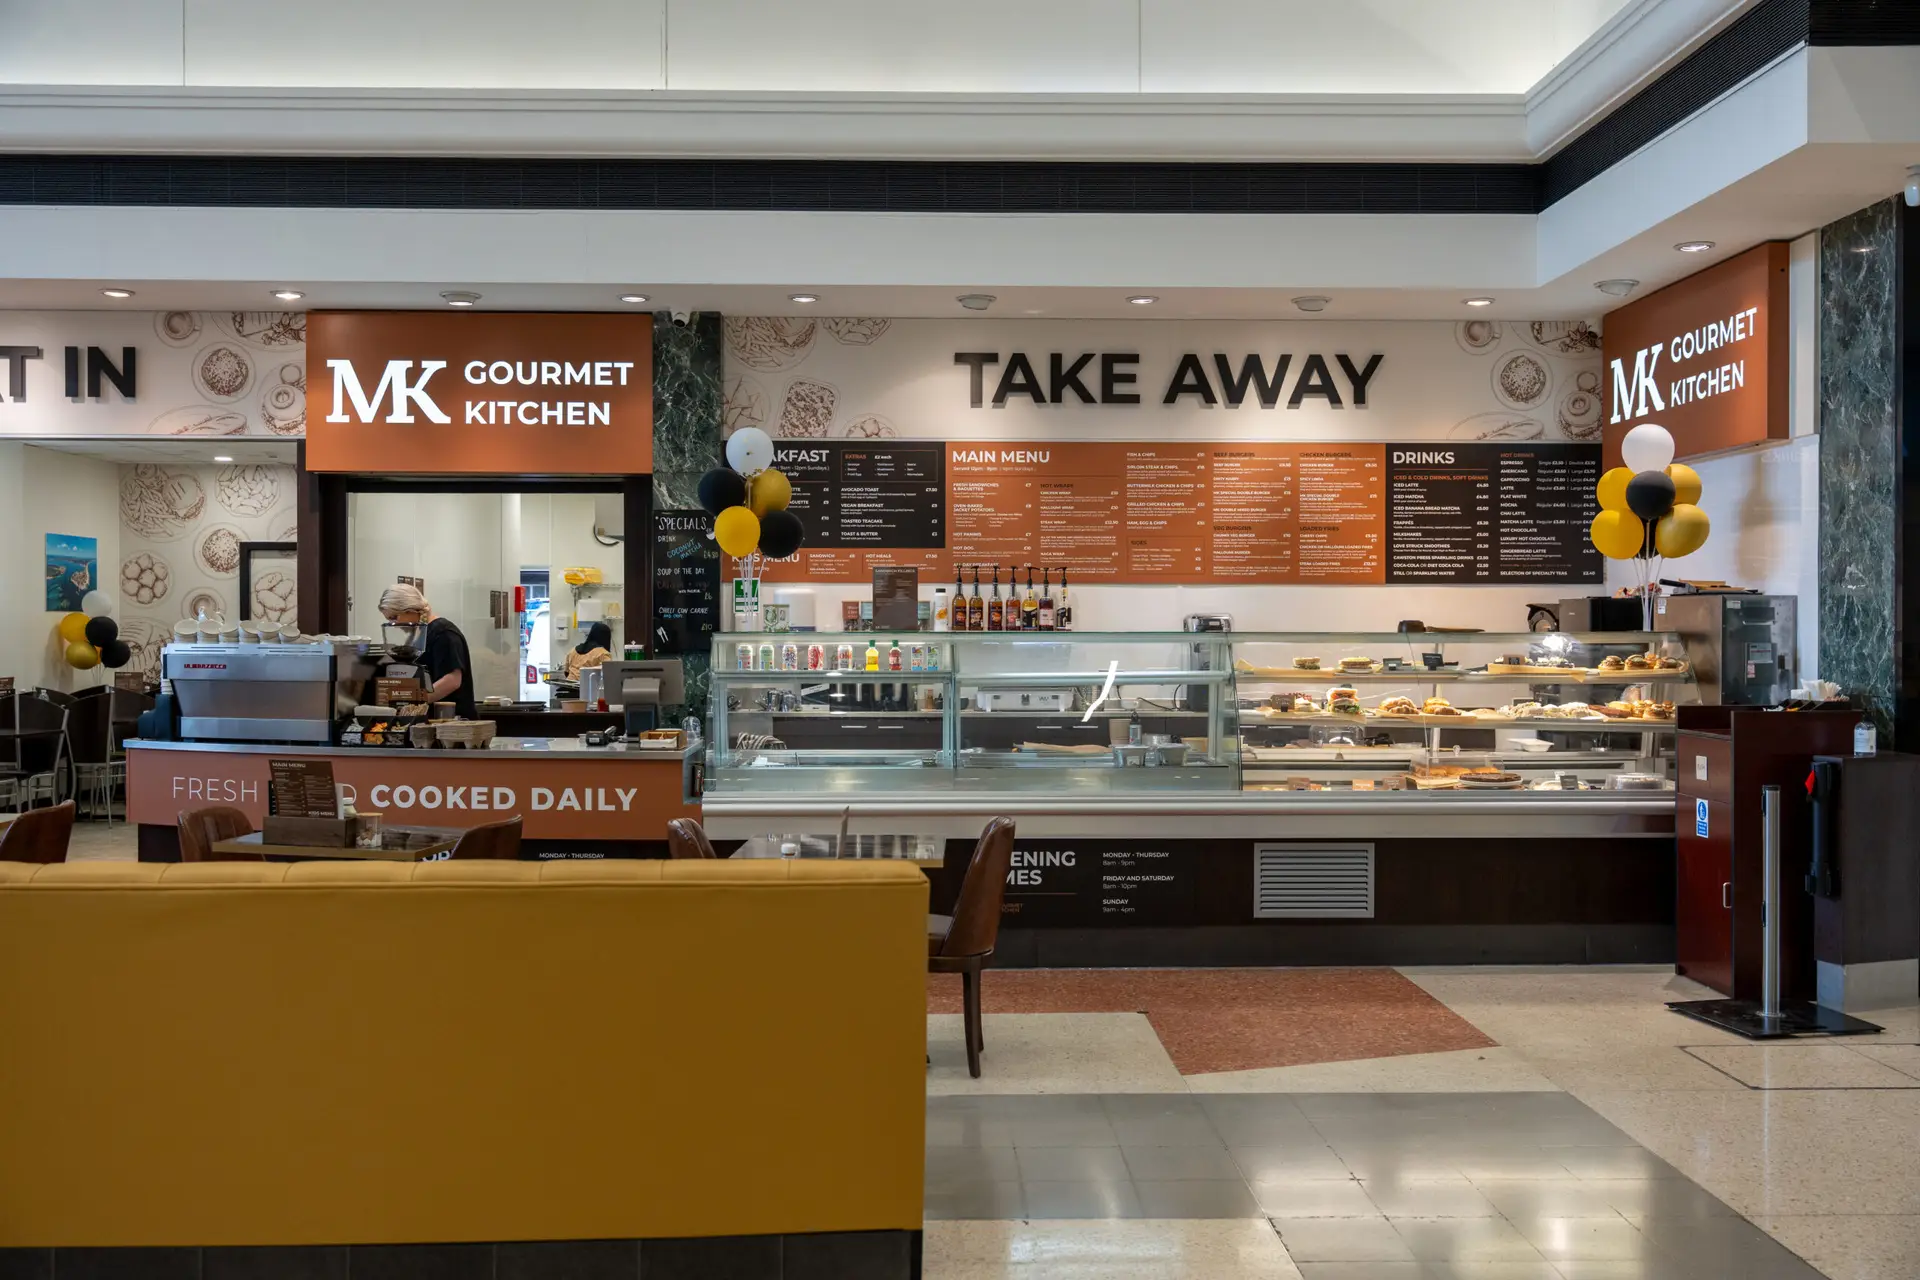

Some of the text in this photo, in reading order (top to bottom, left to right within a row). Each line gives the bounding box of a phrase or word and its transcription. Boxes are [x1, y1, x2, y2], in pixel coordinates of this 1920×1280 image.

[1670, 307, 1758, 363] GOURMET
[0, 346, 136, 400] T IN
[463, 360, 633, 386] GOURMET
[954, 352, 1384, 405] TAKE AWAY
[1610, 342, 1665, 424] MK
[1670, 360, 1745, 407] KITCHEN
[326, 359, 451, 425] MK
[463, 401, 610, 426] KITCHEN
[772, 450, 830, 462] KFAST
[952, 450, 1050, 463] MAIN MENU
[1393, 452, 1455, 464] DRINKS
[658, 516, 707, 530] SPECIALS
[666, 538, 695, 558] COCONUT
[732, 553, 760, 562] KDS
[657, 567, 672, 576] SOUP
[674, 567, 680, 576] OF
[682, 567, 692, 576] THE
[172, 776, 258, 803] FRESH
[370, 784, 516, 811] COOKED
[530, 786, 638, 812] DAILY
[1010, 851, 1075, 866] ENING
